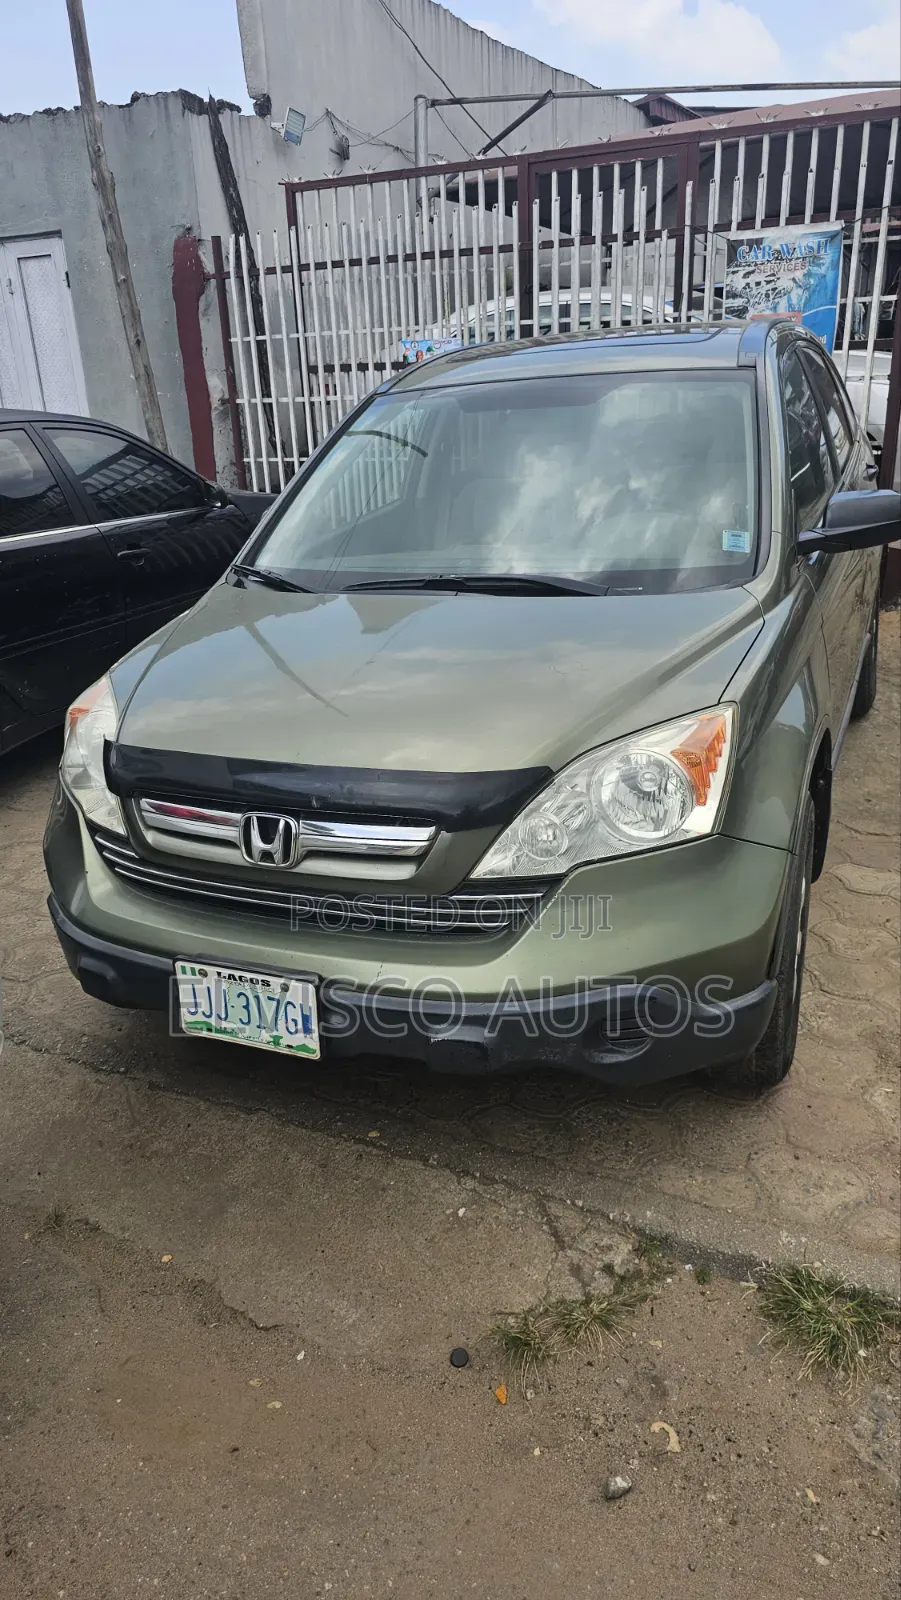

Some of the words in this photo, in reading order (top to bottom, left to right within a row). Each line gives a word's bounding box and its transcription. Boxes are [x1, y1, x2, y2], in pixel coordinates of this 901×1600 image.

[737, 245, 773, 262] CAR
[780, 239, 830, 257] WASH
[756, 262, 807, 273] SERVICES
[216, 970, 272, 988] LAGOS
